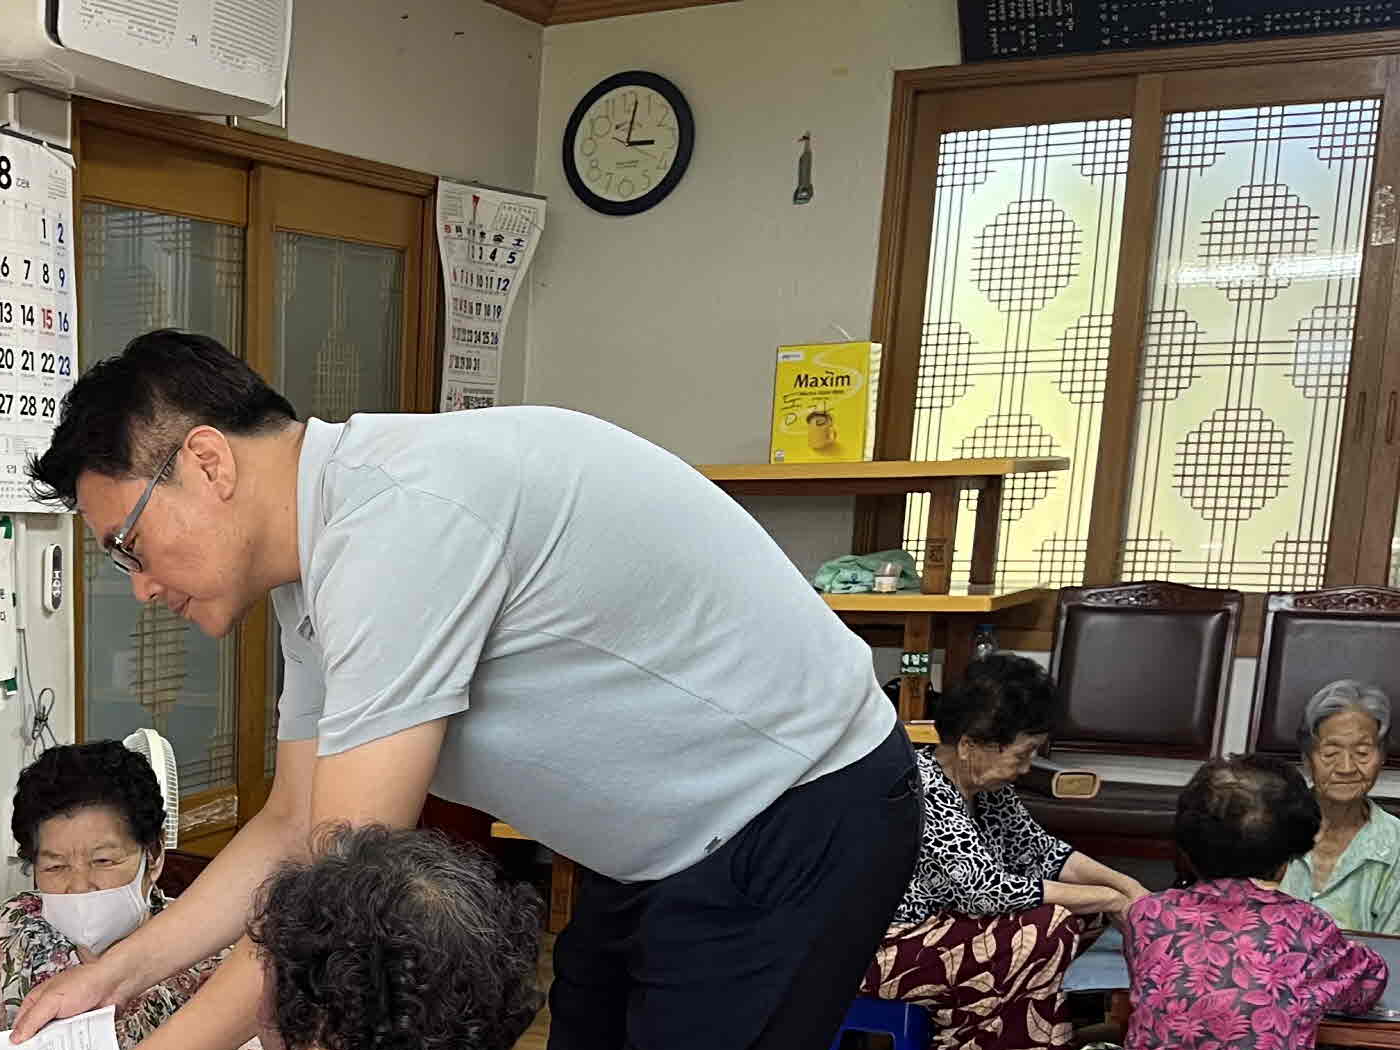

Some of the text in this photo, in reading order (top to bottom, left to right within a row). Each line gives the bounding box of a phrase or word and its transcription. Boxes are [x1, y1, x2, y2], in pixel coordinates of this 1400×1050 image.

[42, 218, 65, 244] 1 2
[489, 248, 517, 264] 4 5
[0, 256, 9, 277] 6
[23, 260, 31, 281] 7
[42, 263, 50, 284] 8
[58, 268, 65, 287] 9
[497, 276, 510, 291] 12
[20, 305, 35, 326] 14
[41, 308, 53, 329] 15
[58, 311, 69, 333] 16
[493, 304, 502, 319] 19
[21, 350, 34, 371] 21
[41, 352, 55, 374] 22
[58, 355, 71, 376] 23
[793, 371, 851, 388] Maxim
[20, 395, 37, 416] 28
[41, 397, 55, 418] 29
